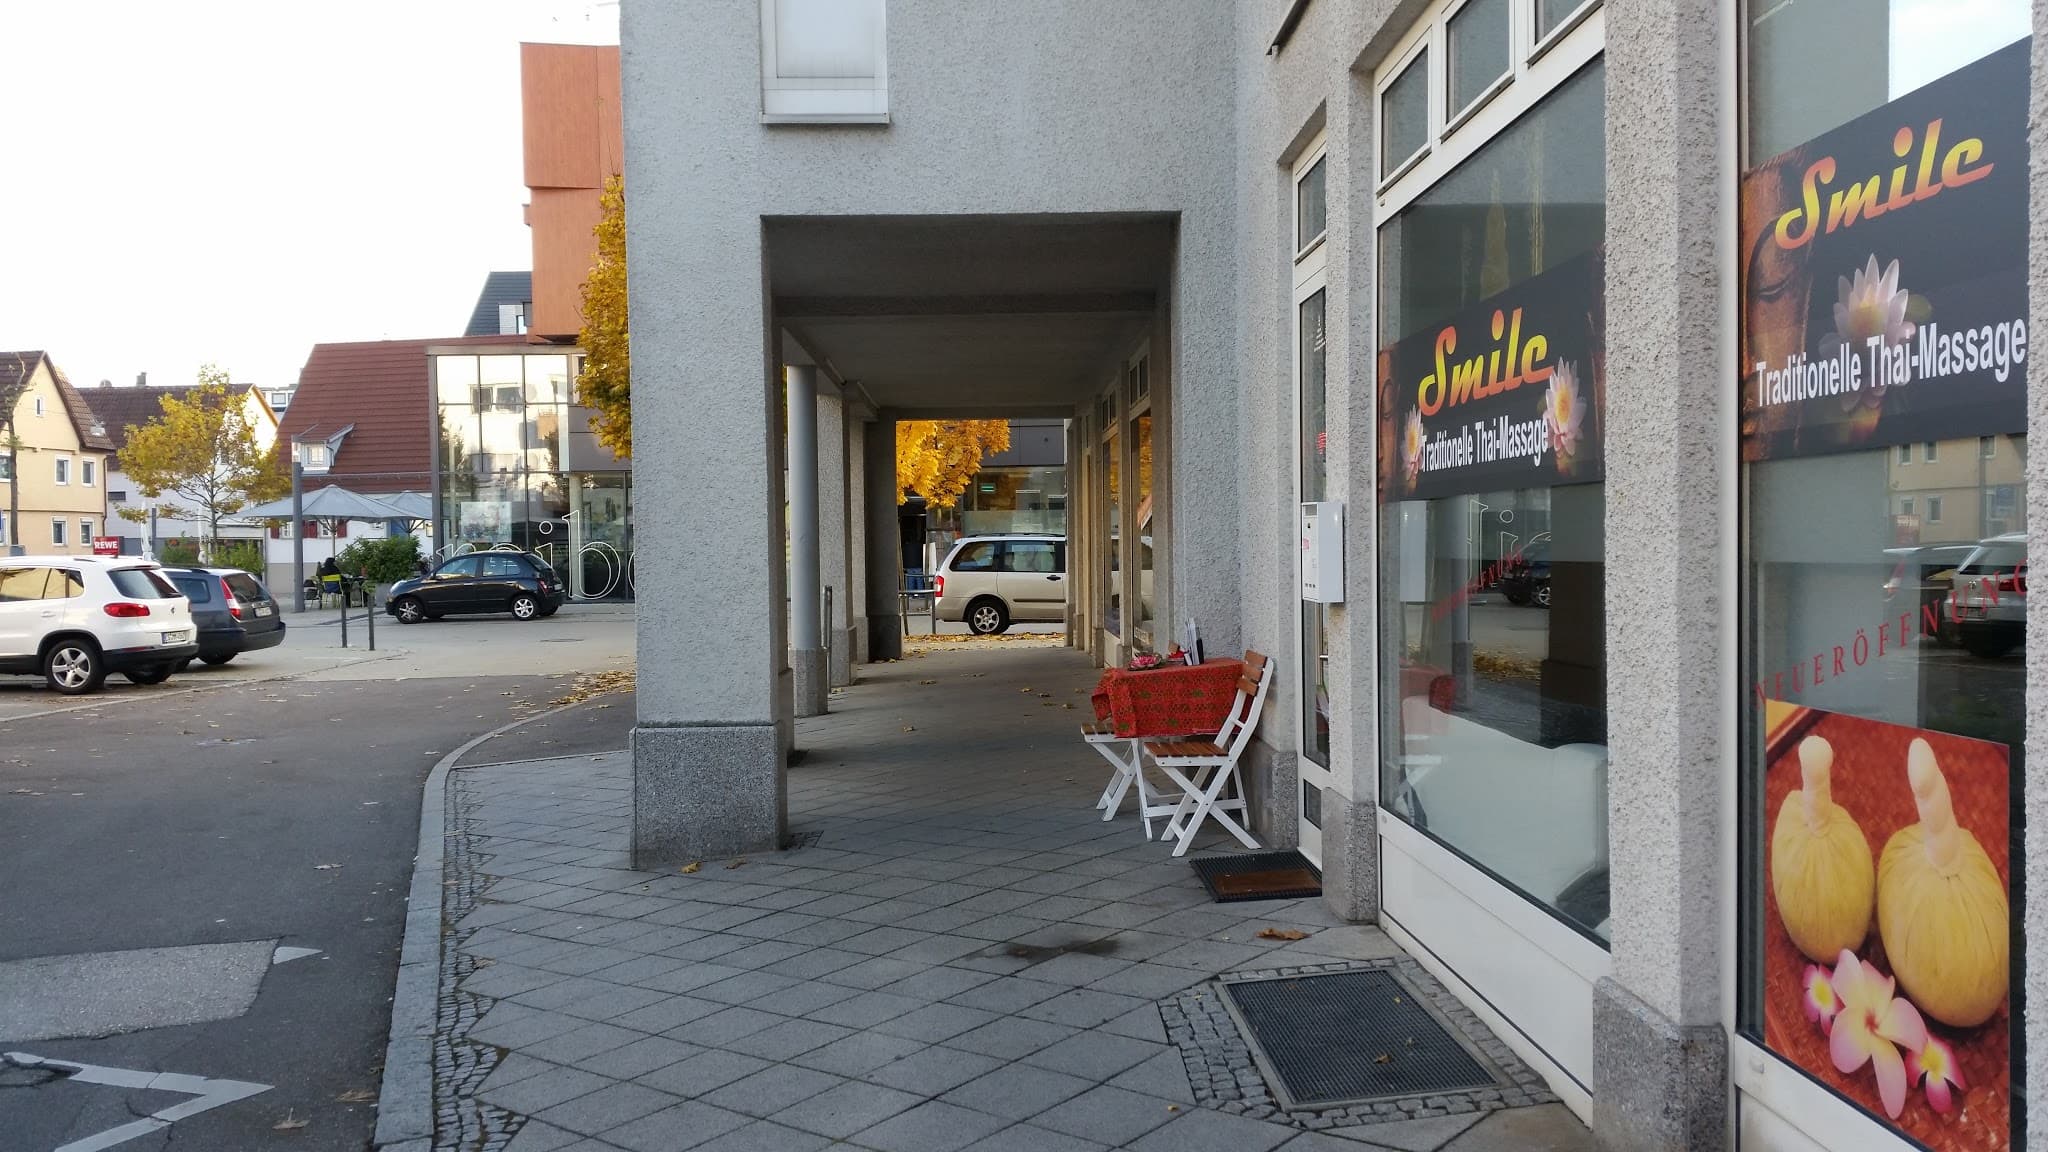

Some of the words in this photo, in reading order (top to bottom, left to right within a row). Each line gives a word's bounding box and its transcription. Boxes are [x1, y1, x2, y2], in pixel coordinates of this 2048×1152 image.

[1775, 117, 1994, 250] Smile
[1417, 306, 1555, 417] Smile
[1756, 342, 1861, 408] Traditionelle
[1867, 316, 2027, 383] Thai-Massage
[1420, 424, 1473, 473] Traditionelle
[1475, 414, 1548, 467] Thai-Massage
[94, 541, 118, 550] REWE
